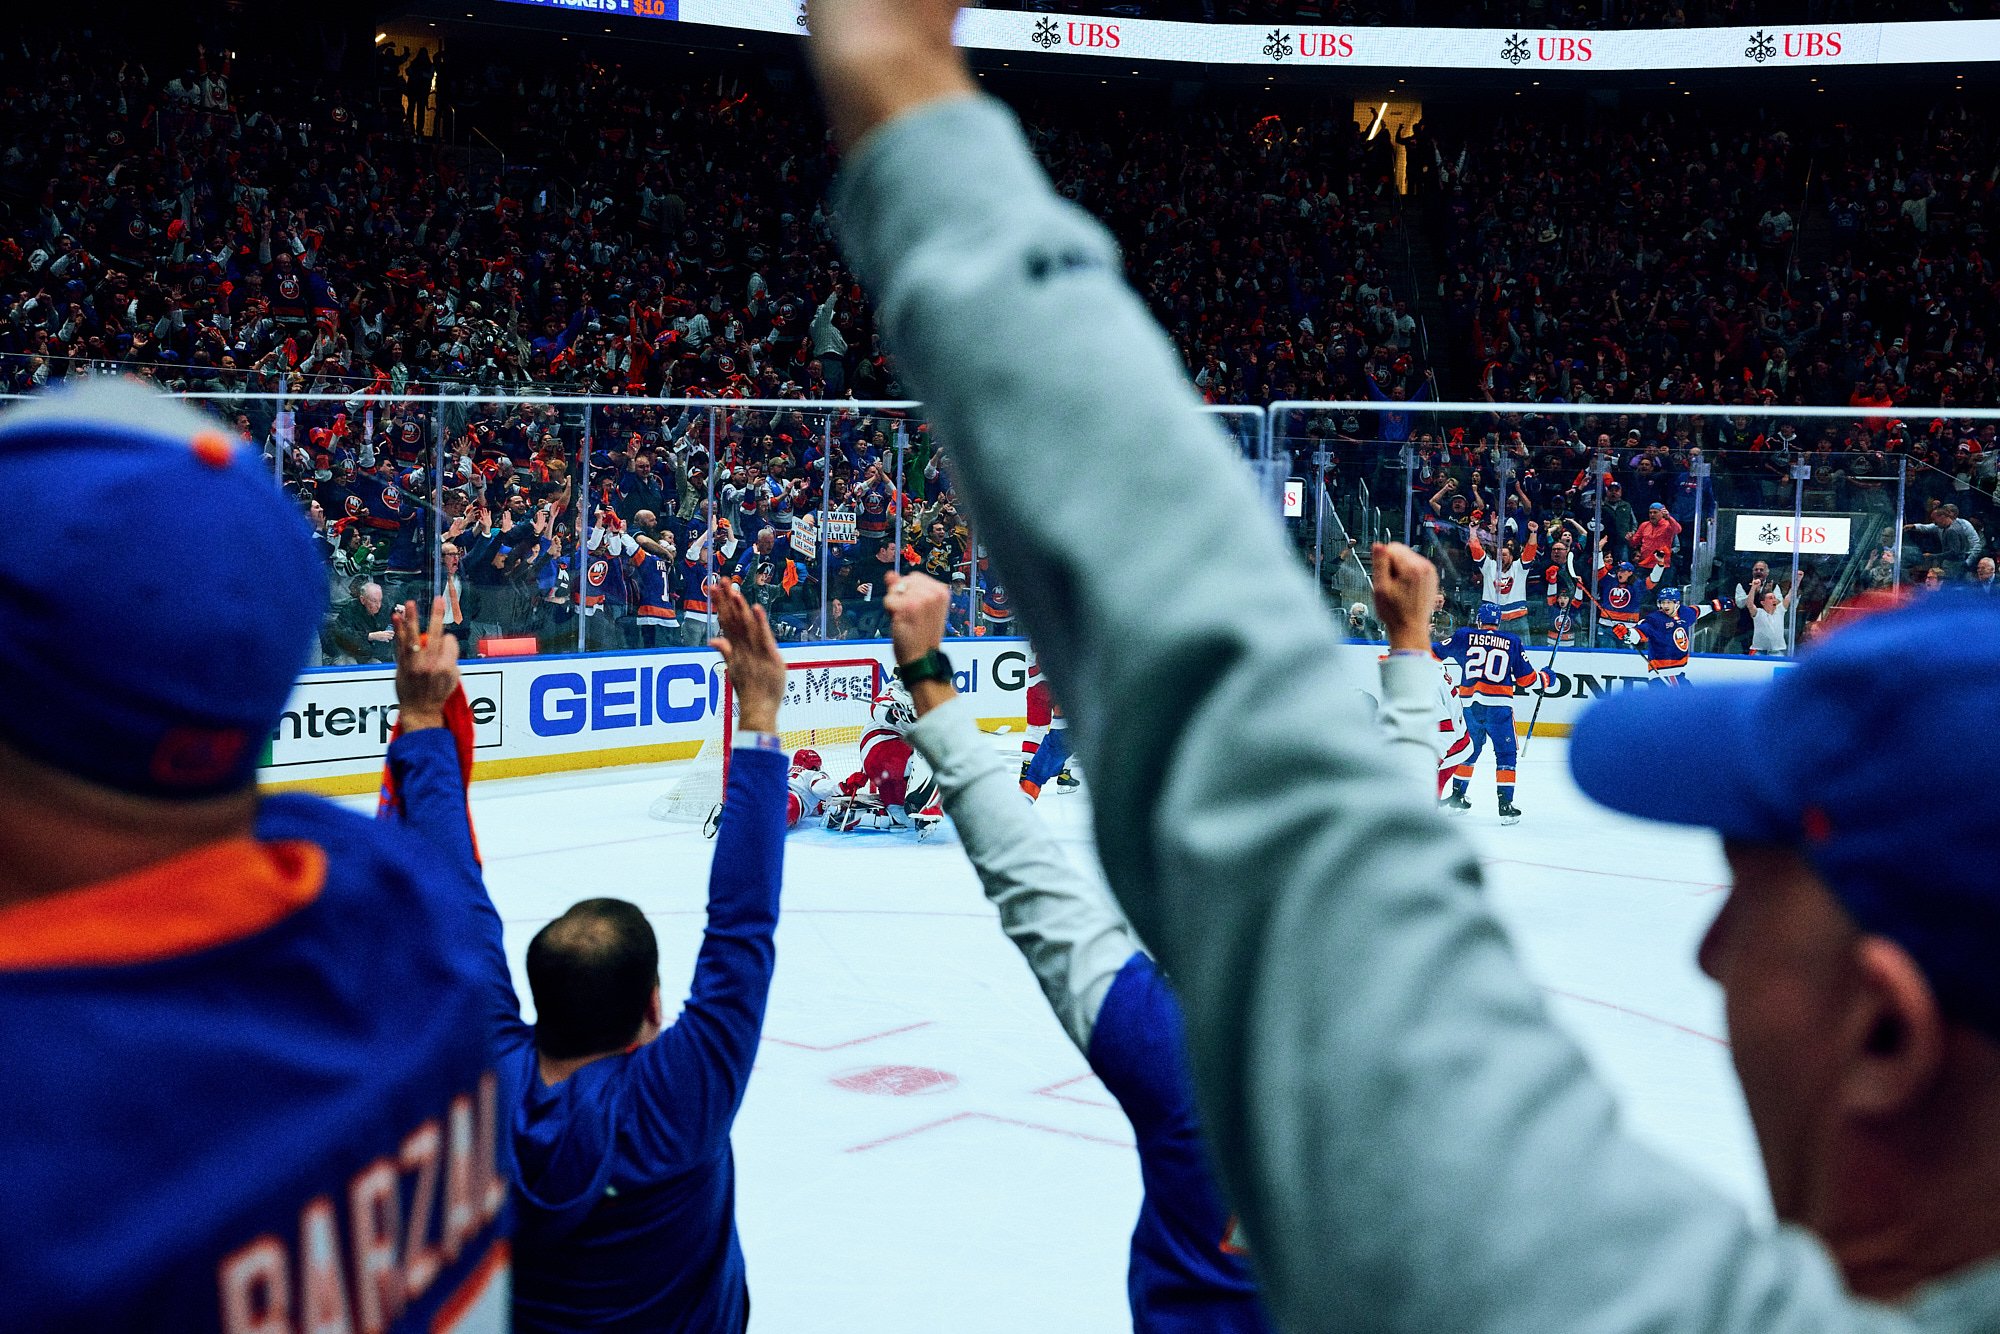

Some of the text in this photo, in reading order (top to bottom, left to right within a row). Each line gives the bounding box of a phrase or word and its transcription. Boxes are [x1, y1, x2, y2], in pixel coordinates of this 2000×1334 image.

[1067, 22, 1120, 48] UBS
[1299, 33, 1353, 57] UBS
[1784, 32, 1842, 57] UBS
[1537, 37, 1592, 62] UBS
[688, 530, 698, 539] 13
[1785, 526, 1826, 543] UBS
[1469, 634, 1511, 651] FASCHING
[1465, 646, 1509, 683] 20
[272, 697, 497, 744] nterpe
